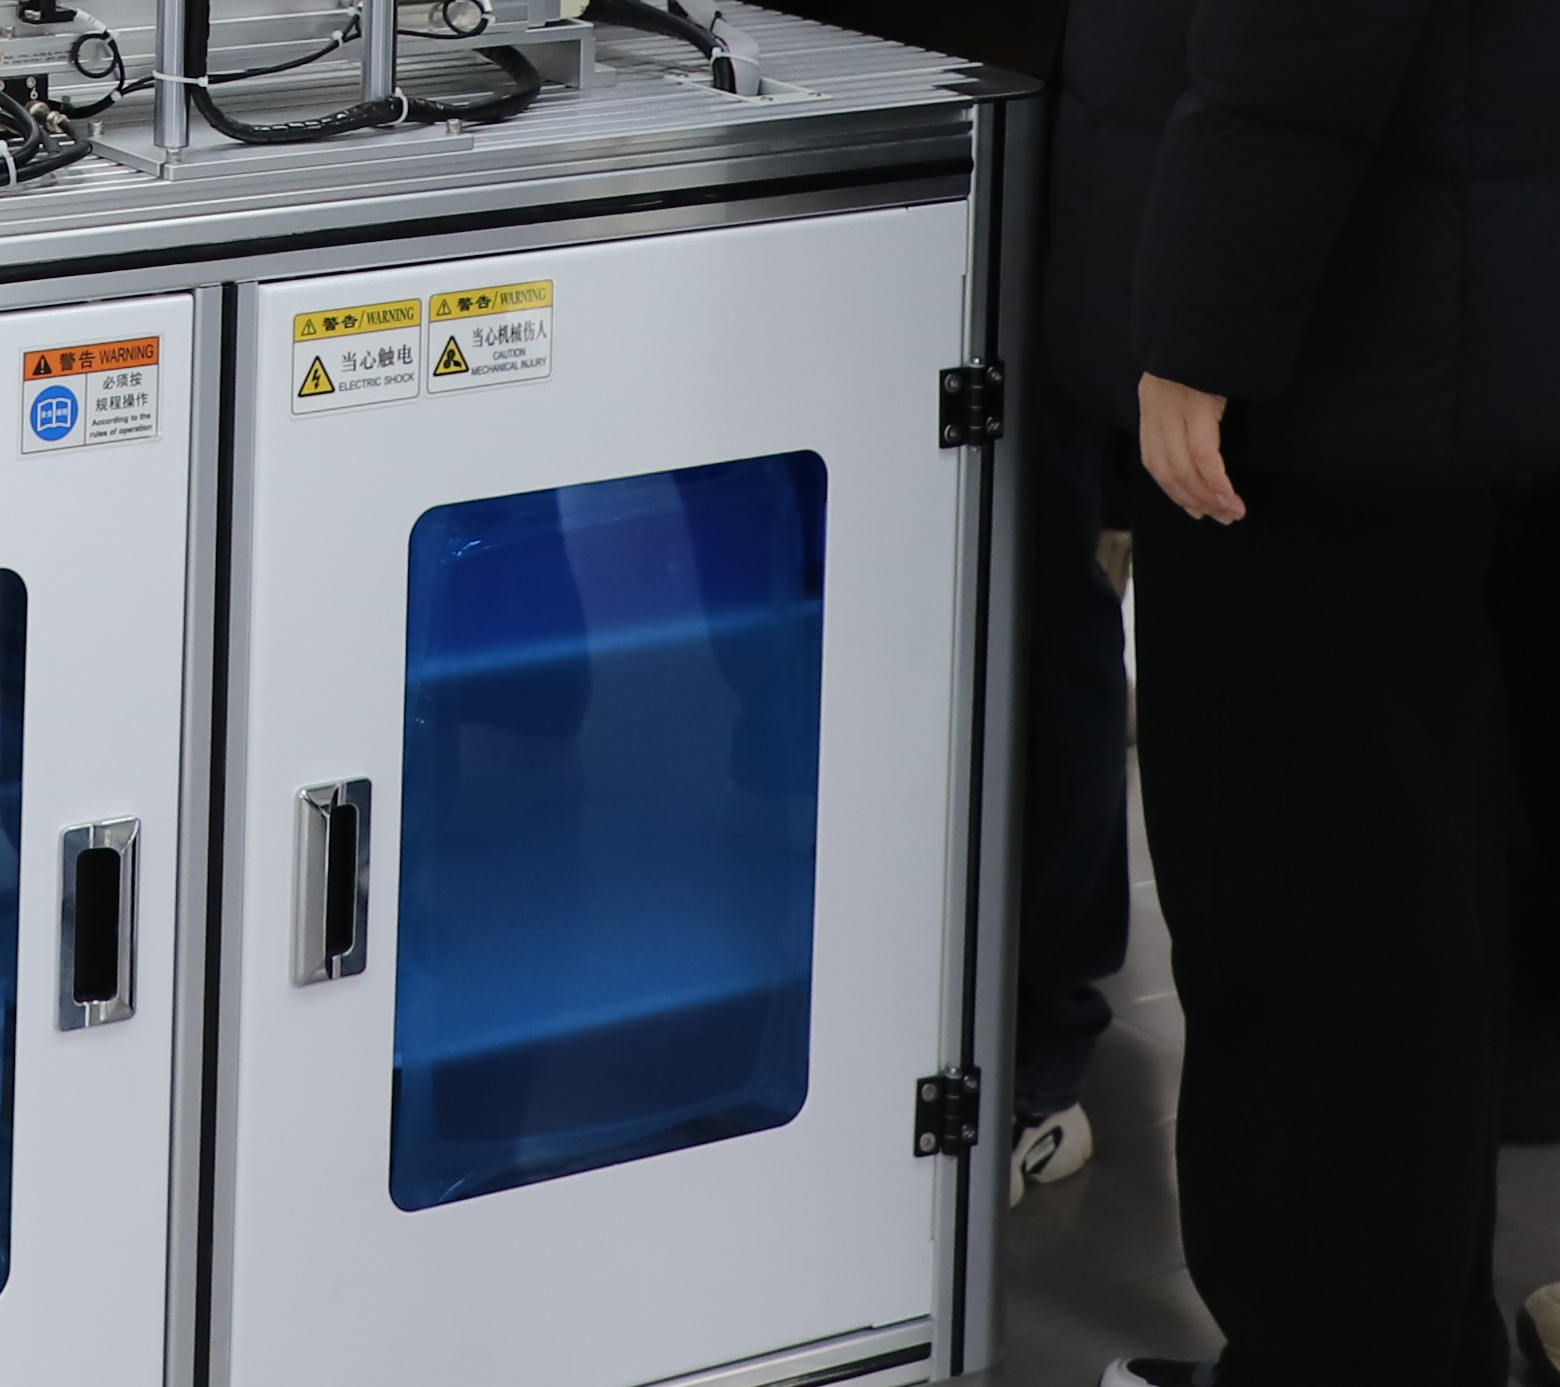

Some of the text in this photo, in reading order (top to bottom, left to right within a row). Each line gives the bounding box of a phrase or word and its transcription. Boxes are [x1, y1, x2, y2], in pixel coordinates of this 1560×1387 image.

[30, 88, 38, 100] 6
[471, 319, 548, 348] 当心机械伤人
[59, 344, 154, 372] 警告 WARNING
[341, 344, 413, 373] 当心触电
[492, 347, 526, 361] CAUTION
[471, 357, 547, 376] MECHANICAL INJURY
[103, 372, 142, 390] 必须按
[339, 373, 415, 391] ELECTRIC SHOCK
[95, 393, 148, 412] 规程操作
[91, 412, 151, 427] According to the
[89, 424, 153, 438] rules of operation
